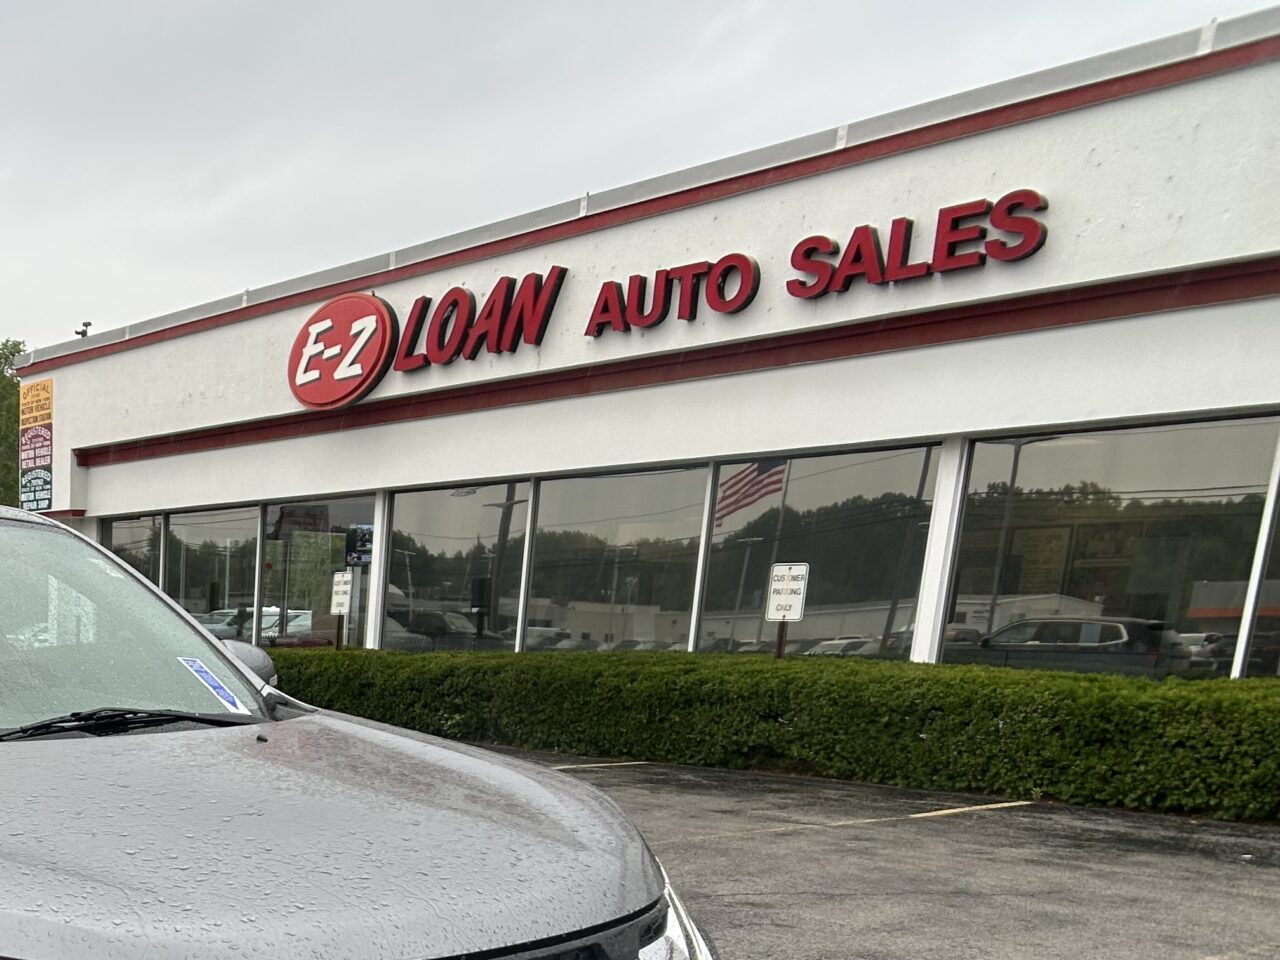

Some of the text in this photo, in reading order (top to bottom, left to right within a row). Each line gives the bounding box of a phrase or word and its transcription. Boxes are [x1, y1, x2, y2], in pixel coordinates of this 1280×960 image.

[295, 189, 1049, 387] E-Z LOAN AUTO SALES
[22, 383, 50, 400] OFFICIAL
[21, 426, 51, 445] REGISTERED
[21, 469, 51, 486] REGISTERED
[773, 574, 805, 582] CUSTOMER
[772, 588, 802, 596] PARKING
[776, 603, 793, 612] ONLY
